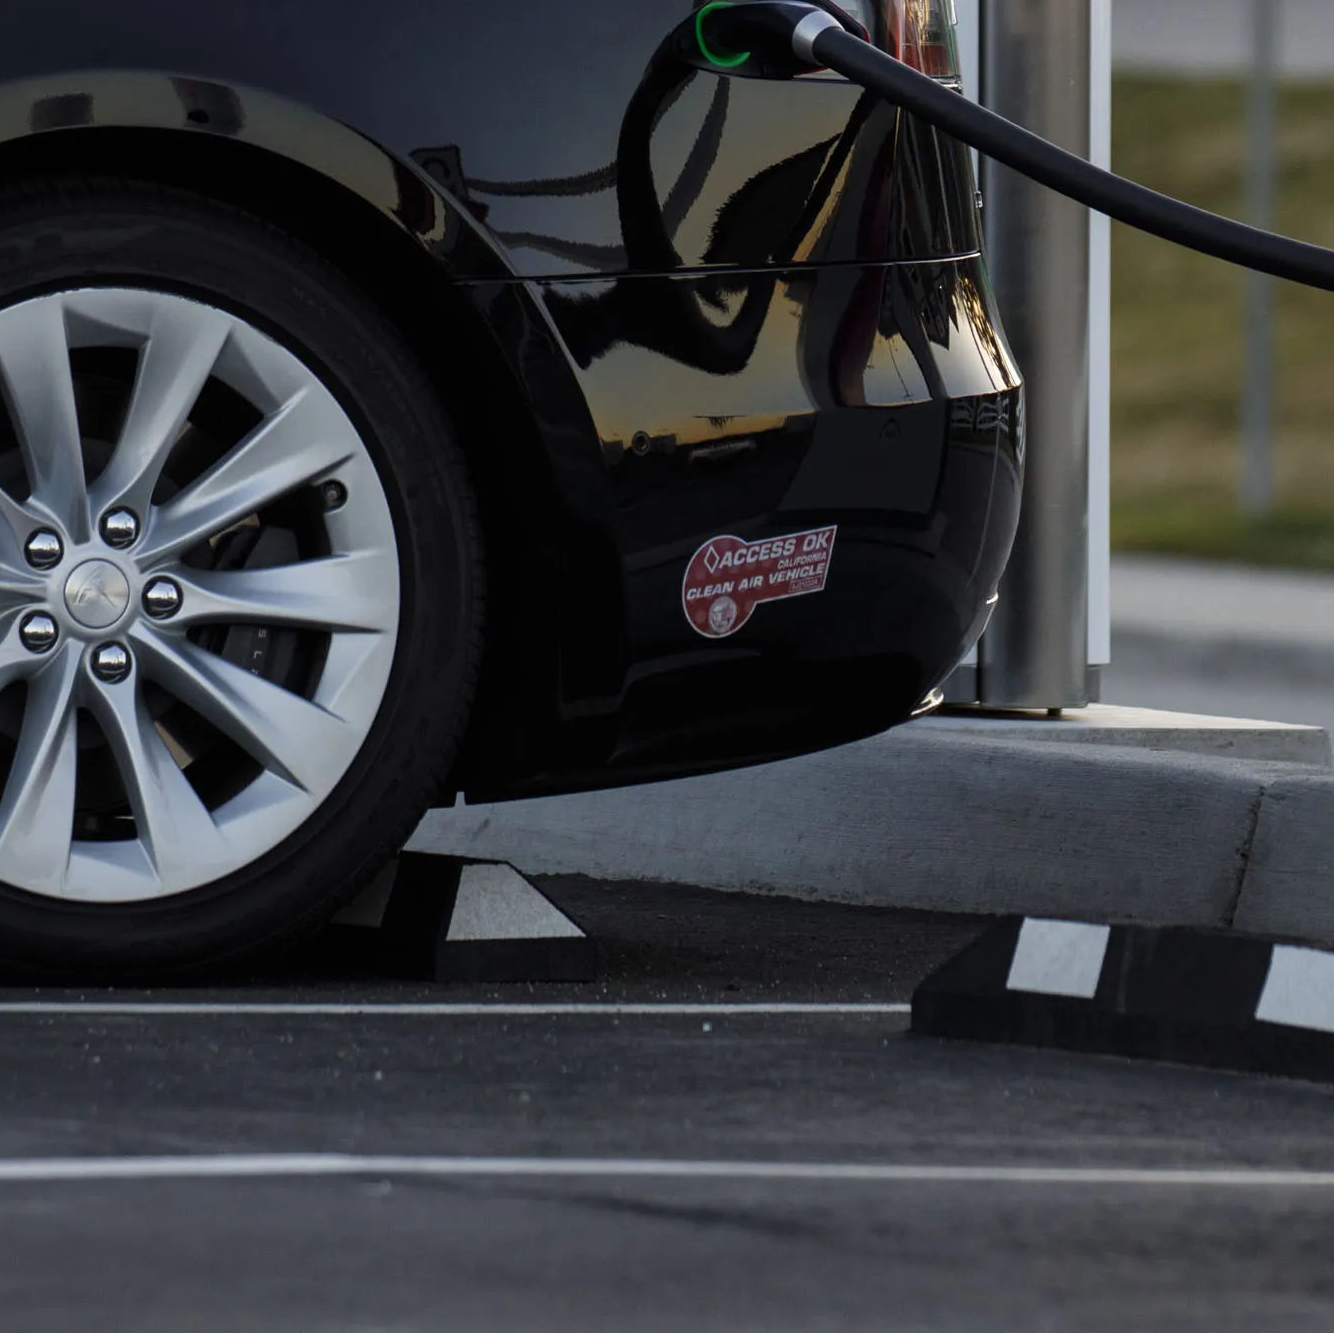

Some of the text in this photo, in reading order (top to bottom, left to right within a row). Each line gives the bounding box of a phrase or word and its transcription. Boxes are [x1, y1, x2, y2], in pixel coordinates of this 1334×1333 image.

[720, 532, 830, 568] ACCESS OK
[778, 553, 827, 569] CALIFORNIA
[686, 580, 734, 601] CLEAN
[738, 575, 764, 591] AIR
[769, 564, 825, 584] VEHICLE
